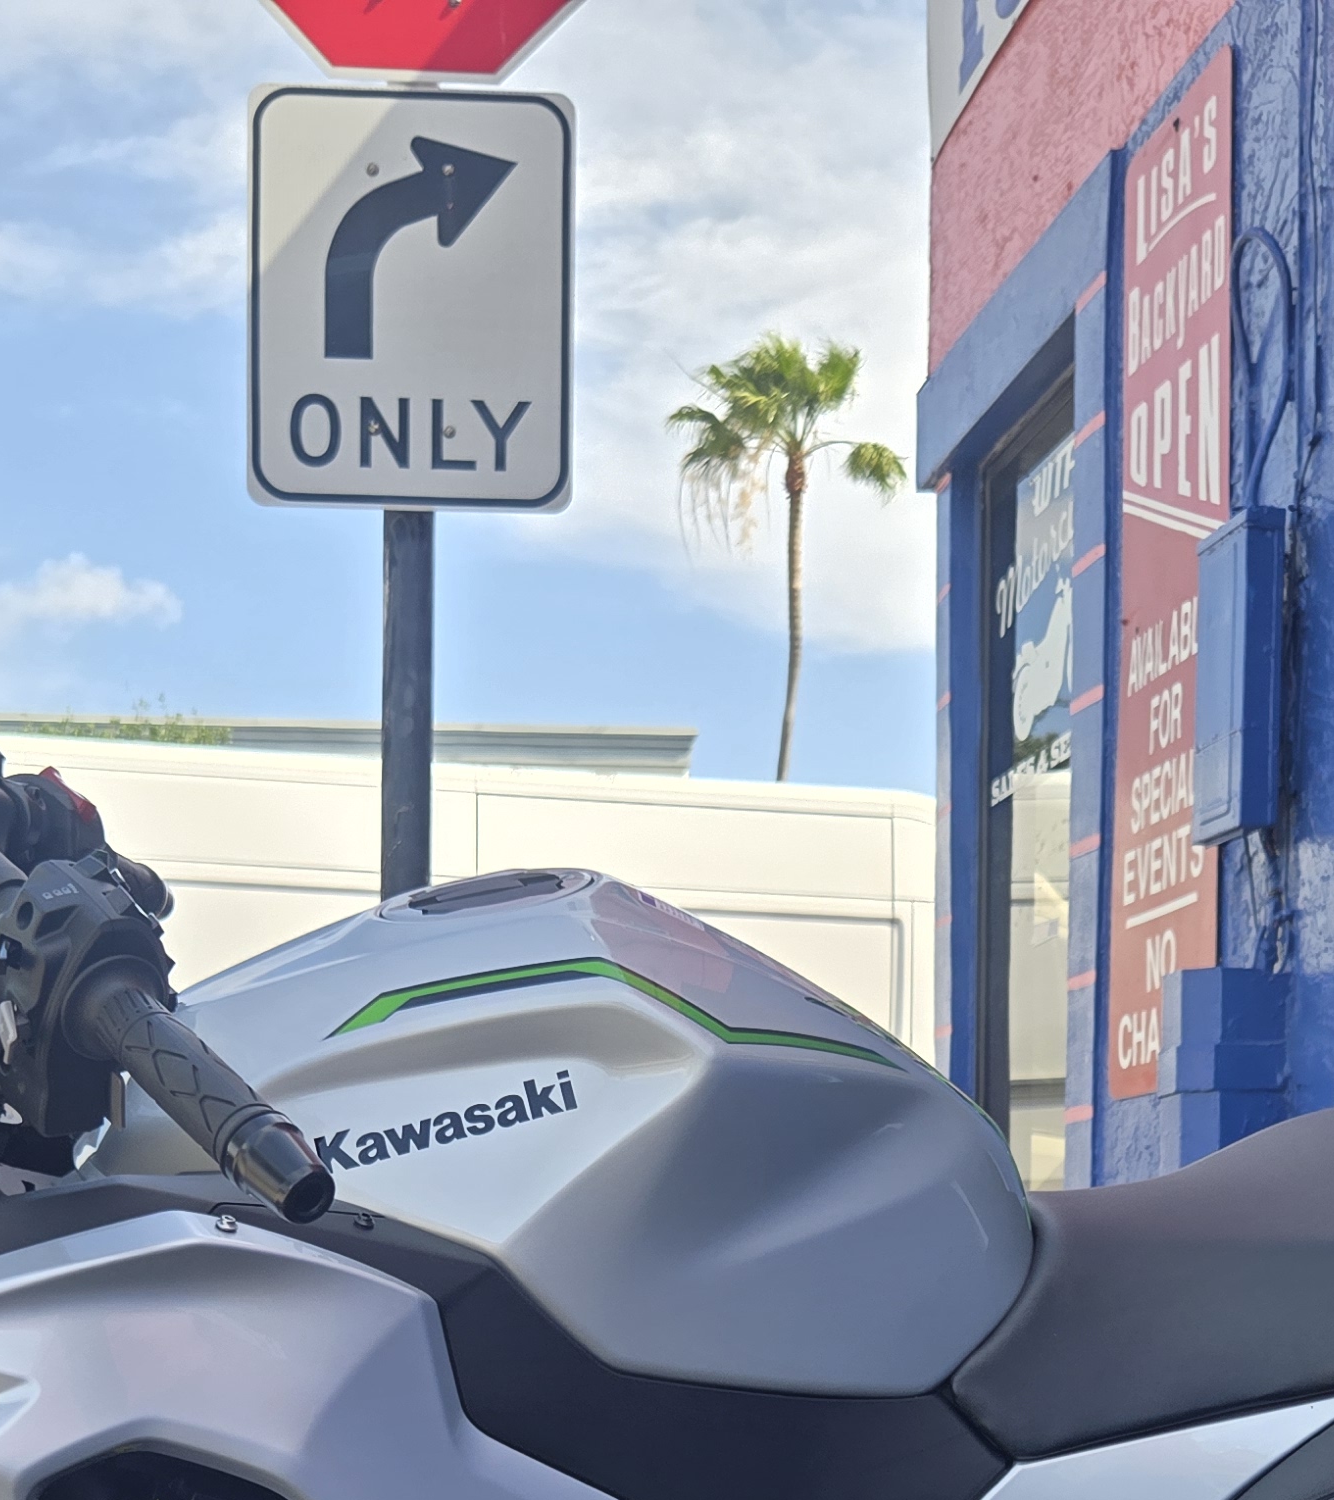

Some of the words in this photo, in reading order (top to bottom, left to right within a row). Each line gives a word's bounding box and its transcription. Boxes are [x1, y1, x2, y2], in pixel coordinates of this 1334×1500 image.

[1135, 94, 1219, 267] LISA'S
[1127, 214, 1226, 378] BACKYARD
[289, 393, 533, 473] ONLY
[1129, 332, 1222, 506] OPEN
[1127, 596, 1199, 697] AVAILABL
[1149, 682, 1183, 756] FOR
[1130, 748, 1195, 835] SPECIAL
[1123, 824, 1206, 907] EVENTS
[1145, 929, 1177, 994] NO
[1117, 1007, 1161, 1070] CHA
[313, 1069, 579, 1174] Kawasaki
